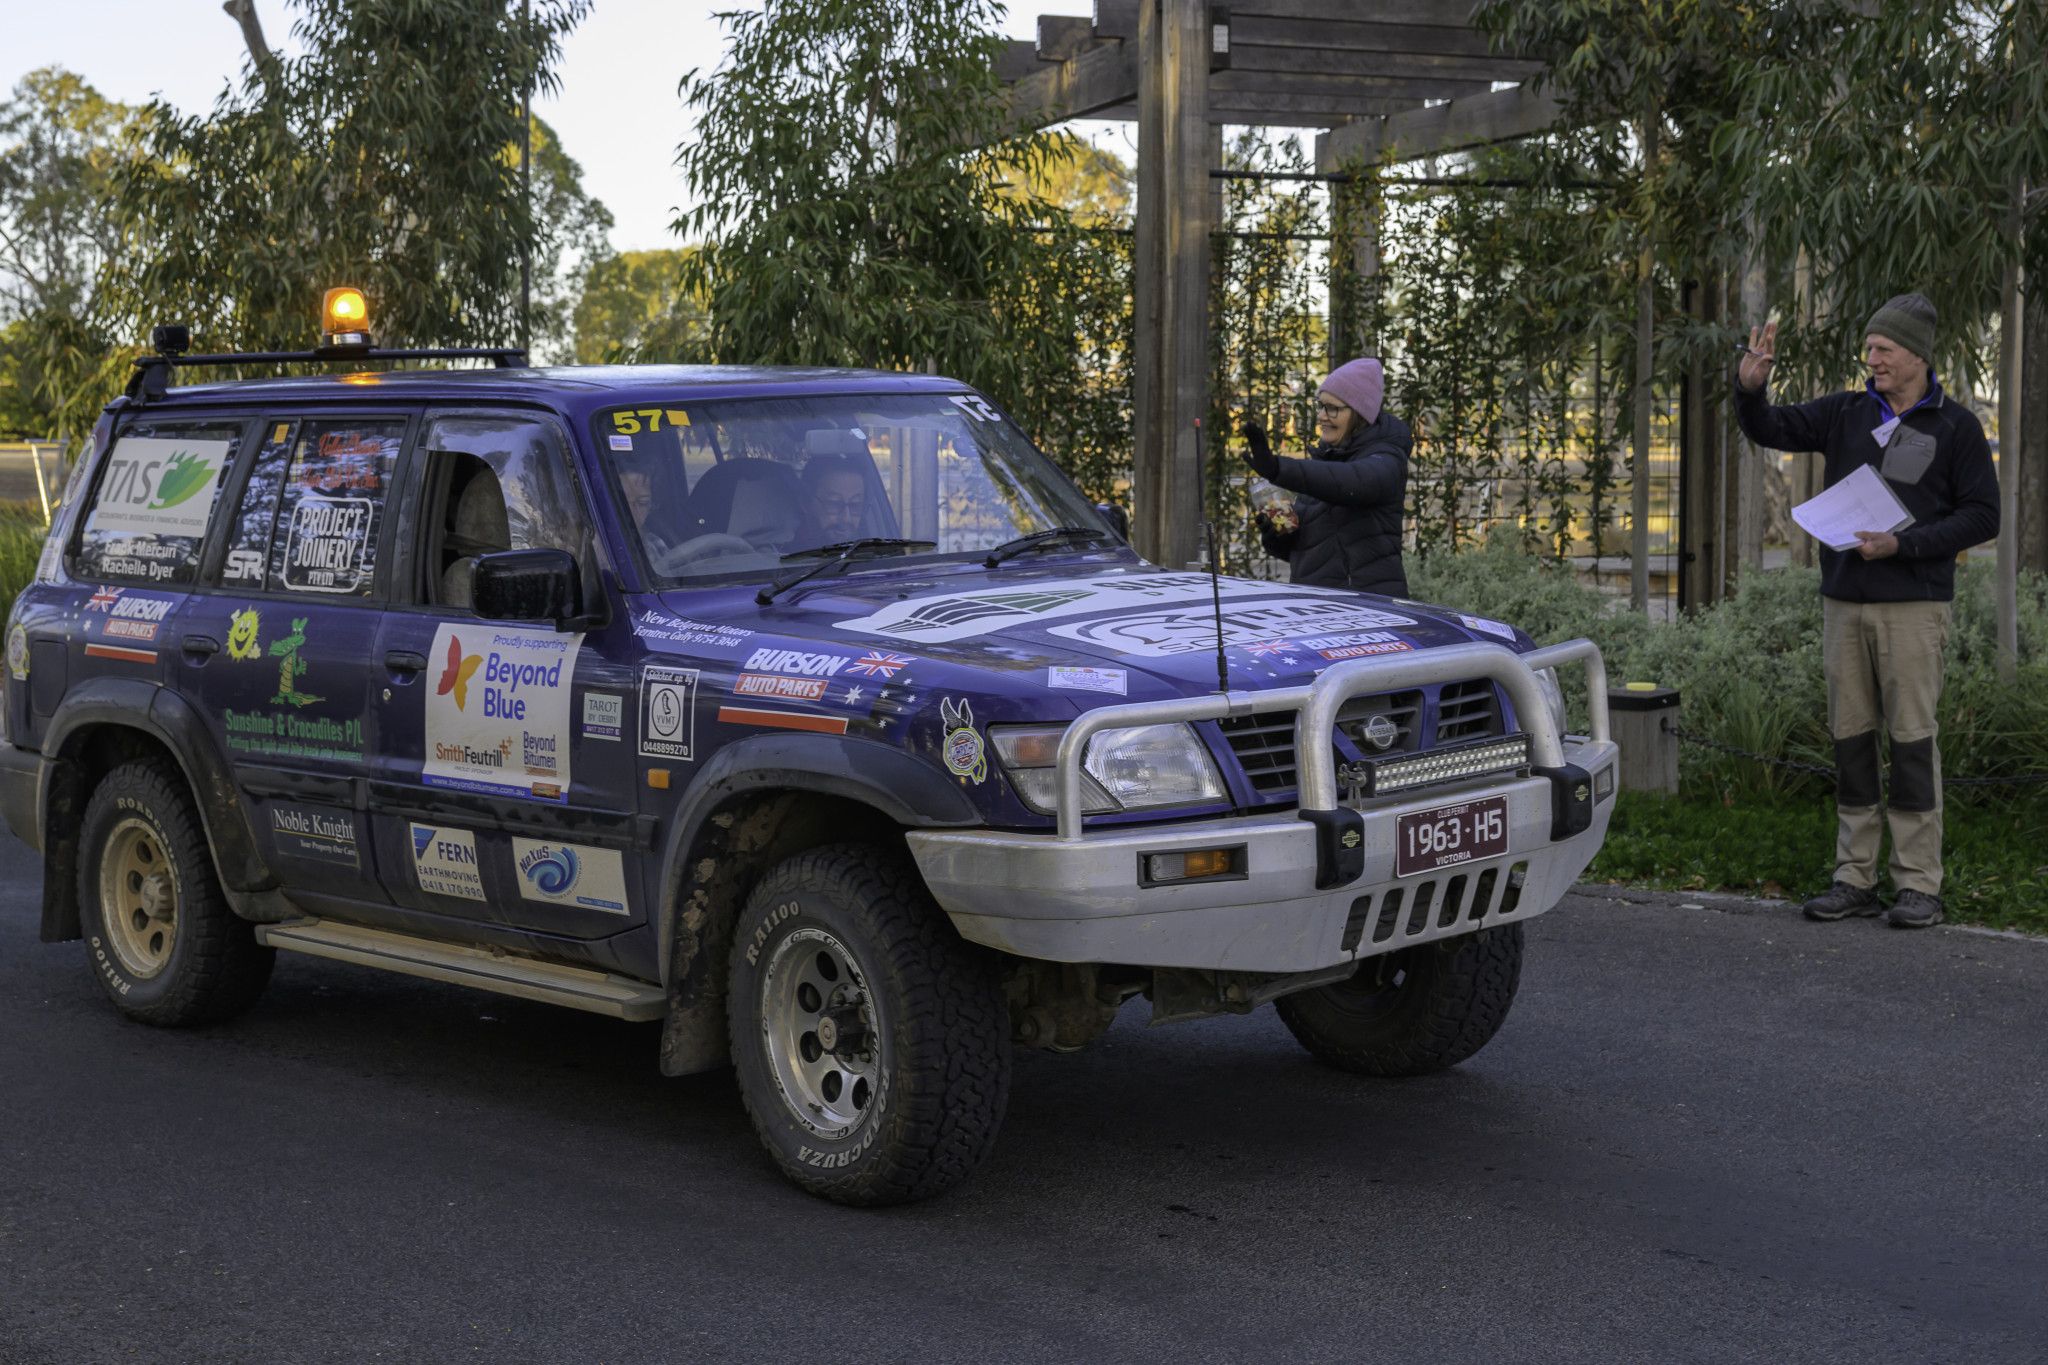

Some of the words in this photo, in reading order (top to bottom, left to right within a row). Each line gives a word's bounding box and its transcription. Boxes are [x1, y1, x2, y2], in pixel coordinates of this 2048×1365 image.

[613, 409, 662, 434] 57
[104, 459, 161, 505] TAS
[300, 507, 364, 538] PROJECT
[294, 538, 357, 570] JOINERY
[102, 556, 147, 576] Rachelle
[149, 561, 175, 581] Dyer
[111, 597, 173, 621] BURSON
[640, 609, 669, 624] New
[106, 621, 128, 634] AUTO
[128, 622, 154, 638] PARTS
[1300, 632, 1400, 650] BURSON
[493, 635, 523, 649] Proudly
[524, 638, 568, 652] supporting
[1328, 647, 1364, 659] AUTO
[1362, 642, 1409, 657] PARTS
[485, 652, 563, 693] Beyond
[743, 648, 850, 677] BURSON
[740, 675, 777, 696] AUTO
[775, 678, 821, 698] PARTS
[484, 688, 526, 720] Blue
[589, 699, 618, 713] TAROT
[225, 708, 274, 734] Sunshine
[276, 713, 286, 736] &
[287, 714, 343, 741] Crocodiles
[1368, 726, 1394, 737] NISSAN
[523, 731, 556, 753] Beyond
[524, 751, 556, 769] Bitumen
[273, 808, 309, 832] Noble
[312, 814, 354, 842] Knight
[438, 841, 476, 865] FERN
[1436, 850, 1471, 865] VICTORIA
[418, 866, 479, 883] EARTHMOVING
